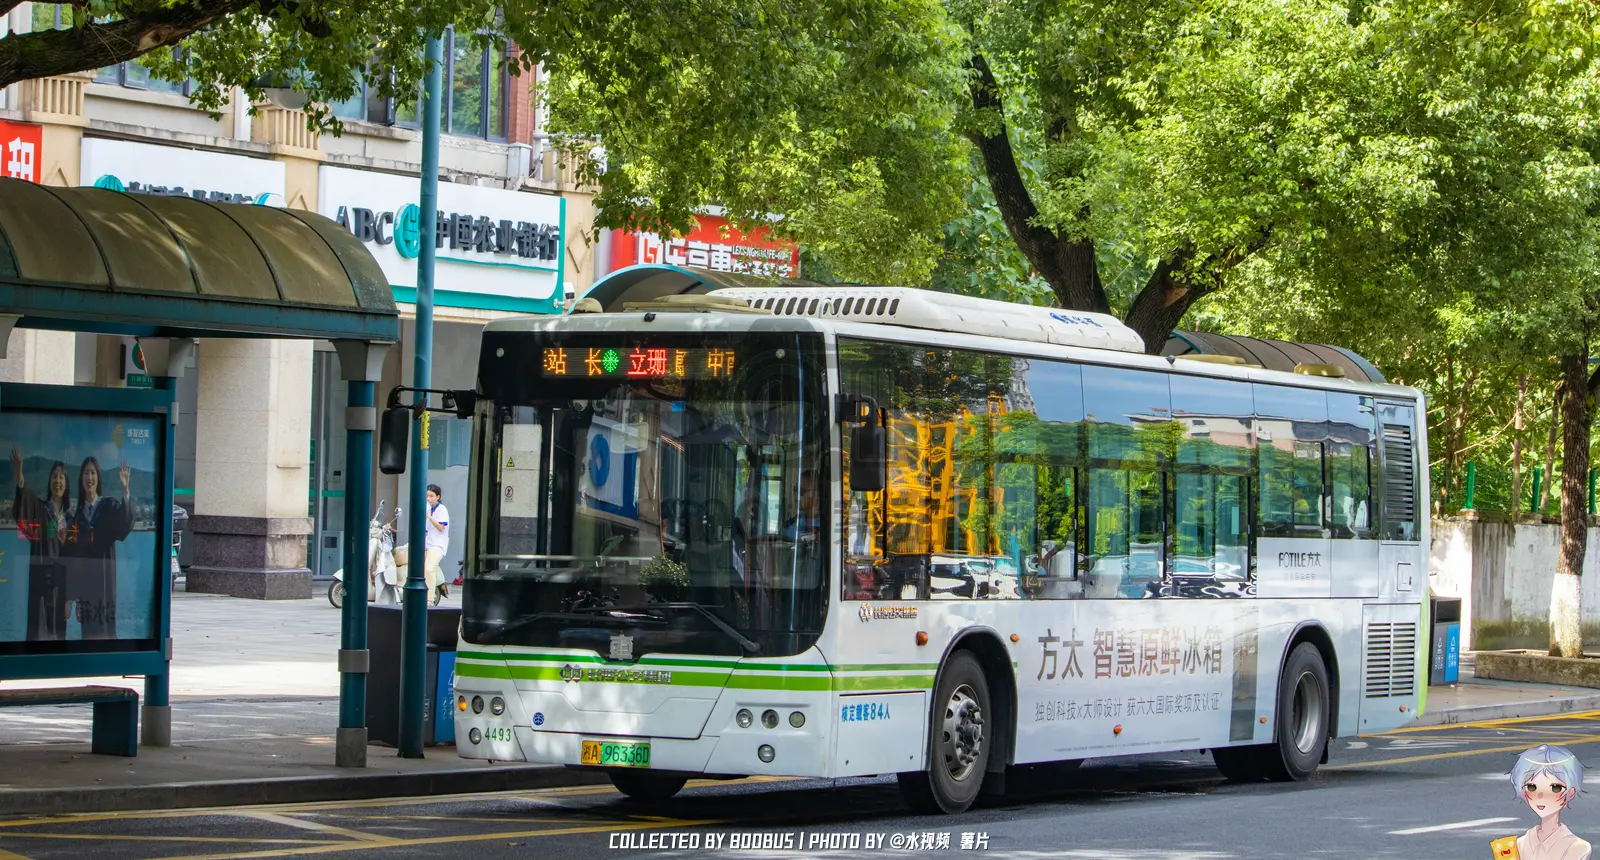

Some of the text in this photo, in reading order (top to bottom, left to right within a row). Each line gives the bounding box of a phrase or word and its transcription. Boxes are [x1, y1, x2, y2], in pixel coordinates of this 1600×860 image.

[0, 137, 34, 181] 租
[336, 205, 394, 245] ABC
[436, 211, 560, 260] 中国农业银行
[628, 348, 667, 375] 立珊
[1278, 552, 1306, 568] FOTILE
[1037, 625, 1223, 681] 方太 智慧原鲜冰箱
[485, 727, 511, 742] 4493
[605, 745, 650, 763] 96336D
